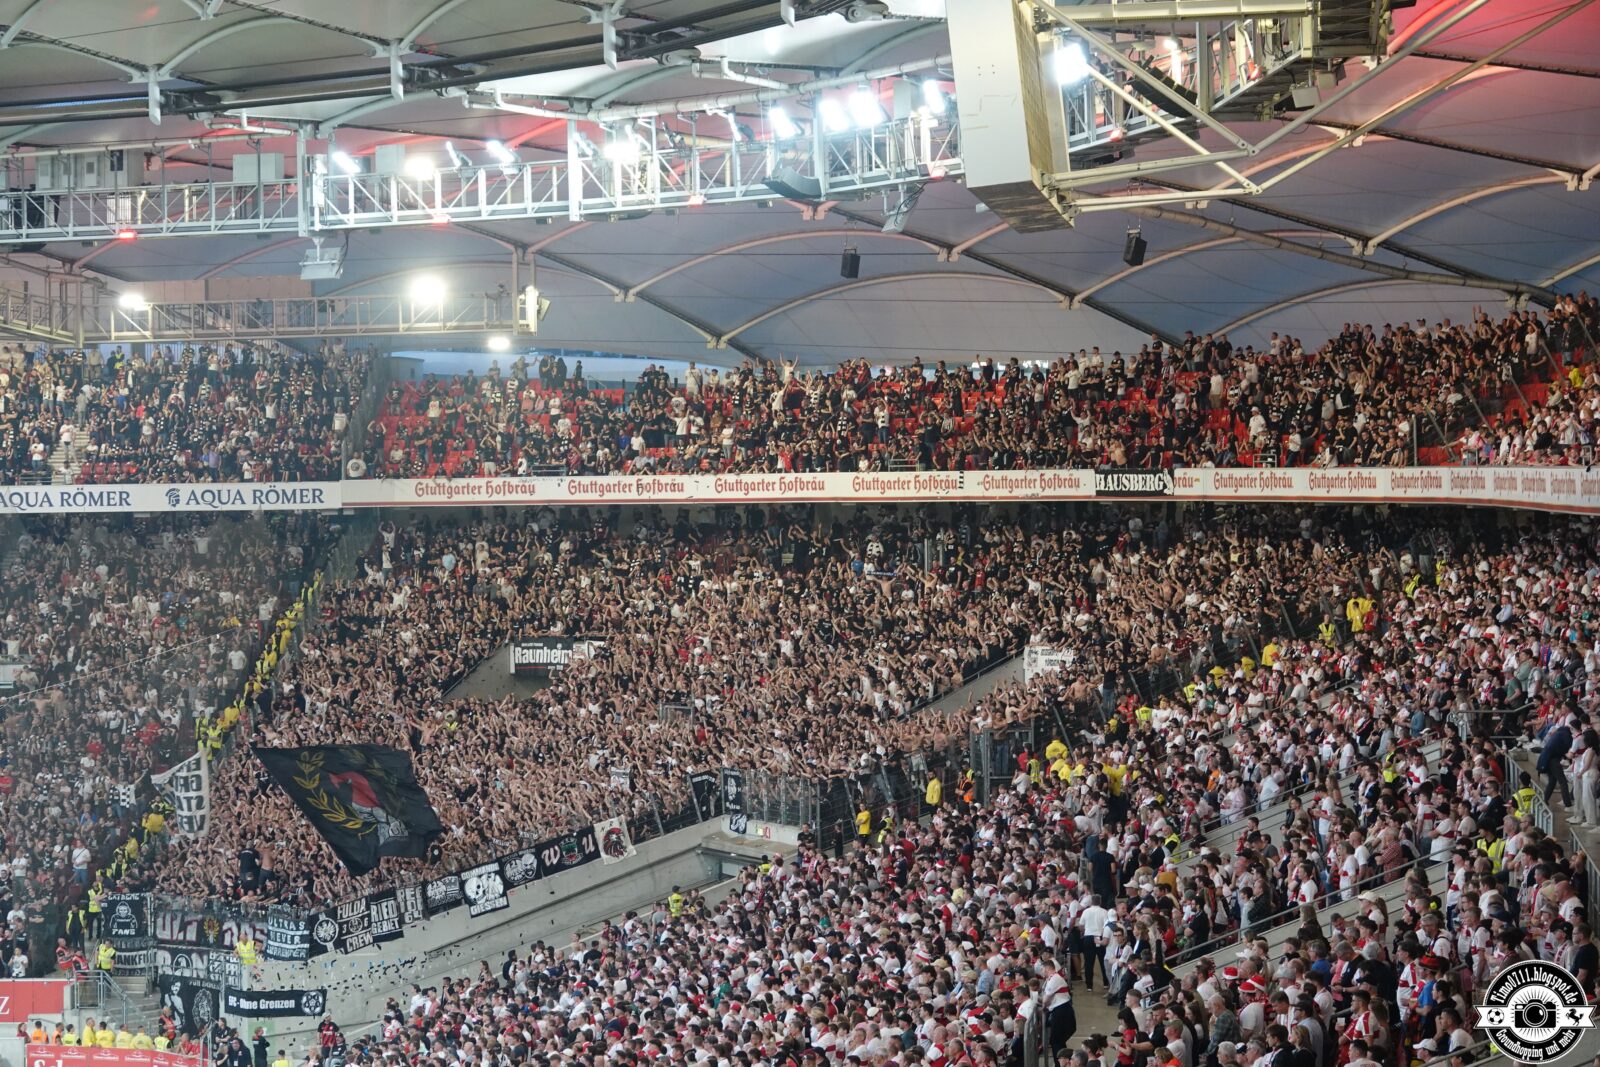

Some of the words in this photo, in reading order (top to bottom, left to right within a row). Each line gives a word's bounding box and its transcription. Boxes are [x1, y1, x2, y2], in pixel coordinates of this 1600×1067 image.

[415, 481, 482, 499] Stuttgarter
[485, 480, 536, 498] Hofbräu
[568, 480, 633, 498] Stuttgarter
[636, 479, 684, 496] Hofbräu
[714, 478, 777, 496] Stuttgarter
[779, 476, 825, 495] Hofbräu
[852, 476, 912, 494] Stuttgarter
[914, 475, 958, 494] Hofbräu
[983, 475, 1037, 493] Stuttgarter
[1039, 473, 1080, 492] Hofbräu
[1095, 473, 1164, 491] HAUSBERG
[1213, 472, 1257, 493] Stuttgarter
[1258, 471, 1293, 493] Hofbräu
[0, 491, 53, 511] AQUA
[60, 487, 131, 507] RÖMER
[186, 489, 246, 508] AQUA
[252, 485, 324, 505] RÖMER
[337, 897, 366, 920] FULDA
[370, 899, 398, 923] RIED
[470, 896, 508, 916] GIESSEN
[371, 918, 400, 934] GEBIET
[346, 931, 373, 953] CREW
[259, 999, 296, 1010] Grenzen
